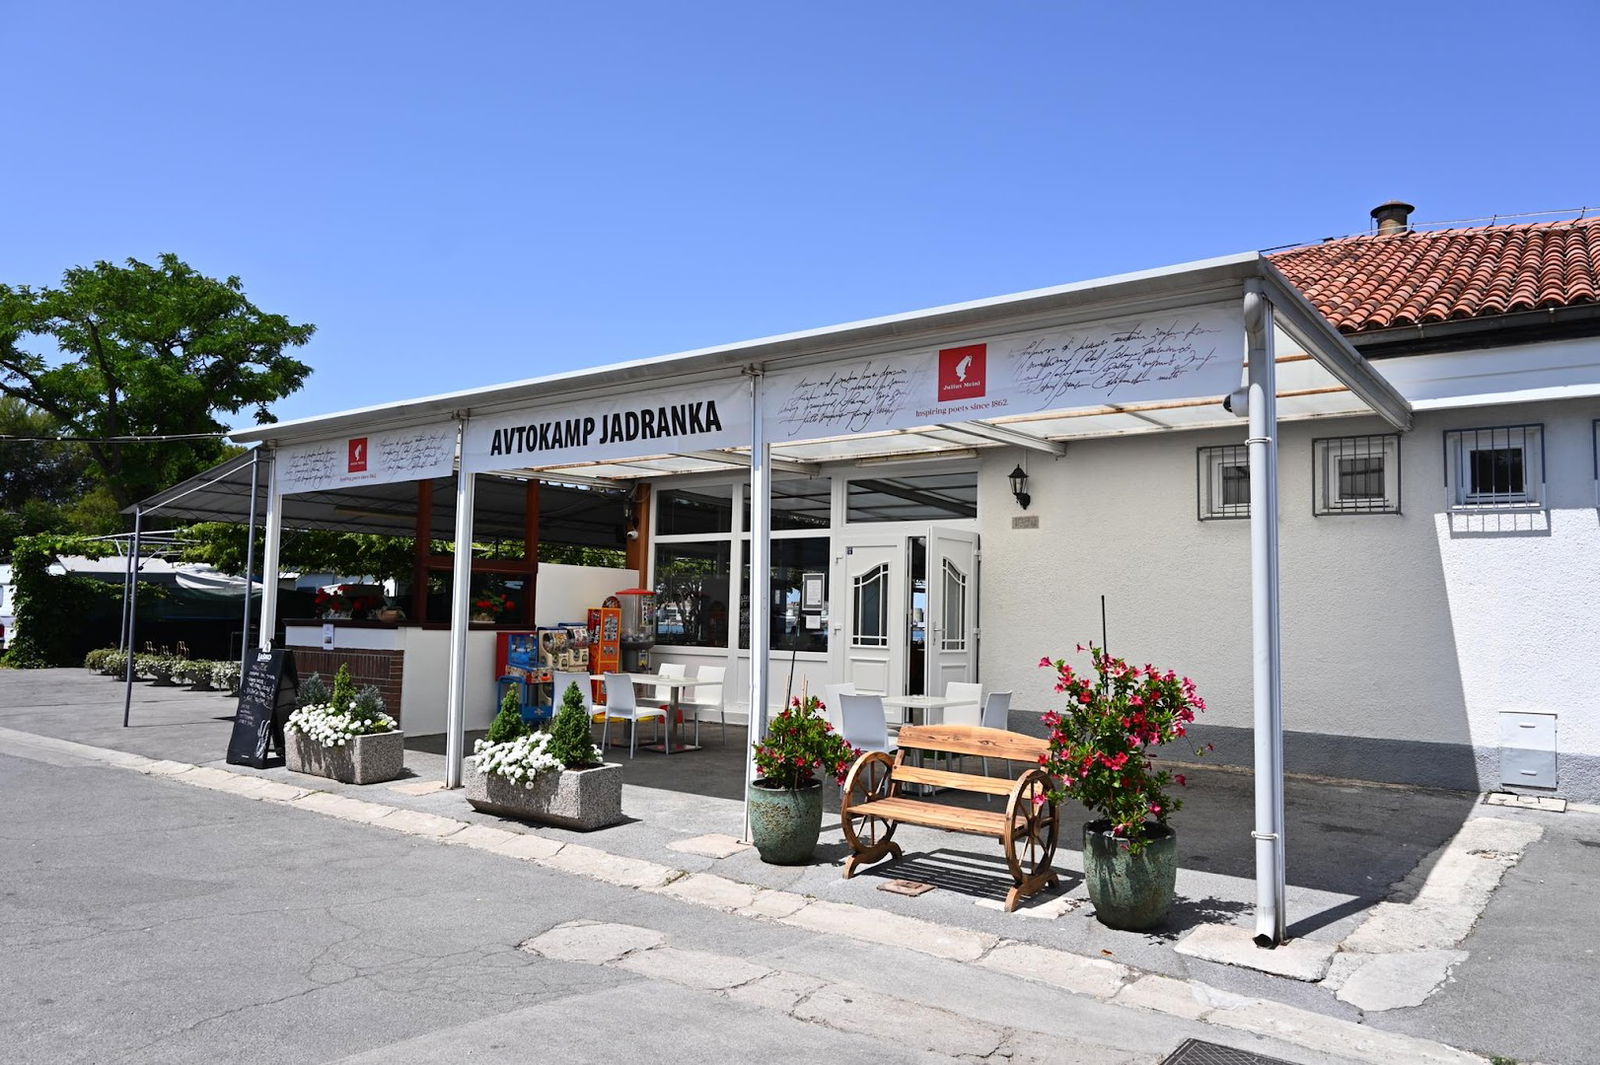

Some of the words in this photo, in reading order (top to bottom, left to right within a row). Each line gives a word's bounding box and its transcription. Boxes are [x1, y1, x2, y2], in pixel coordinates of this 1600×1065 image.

[490, 416, 596, 456] AVTOKAMP
[599, 400, 723, 445] JADRANKA
[915, 407, 947, 418] Inspiring
[948, 404, 969, 415] poets
